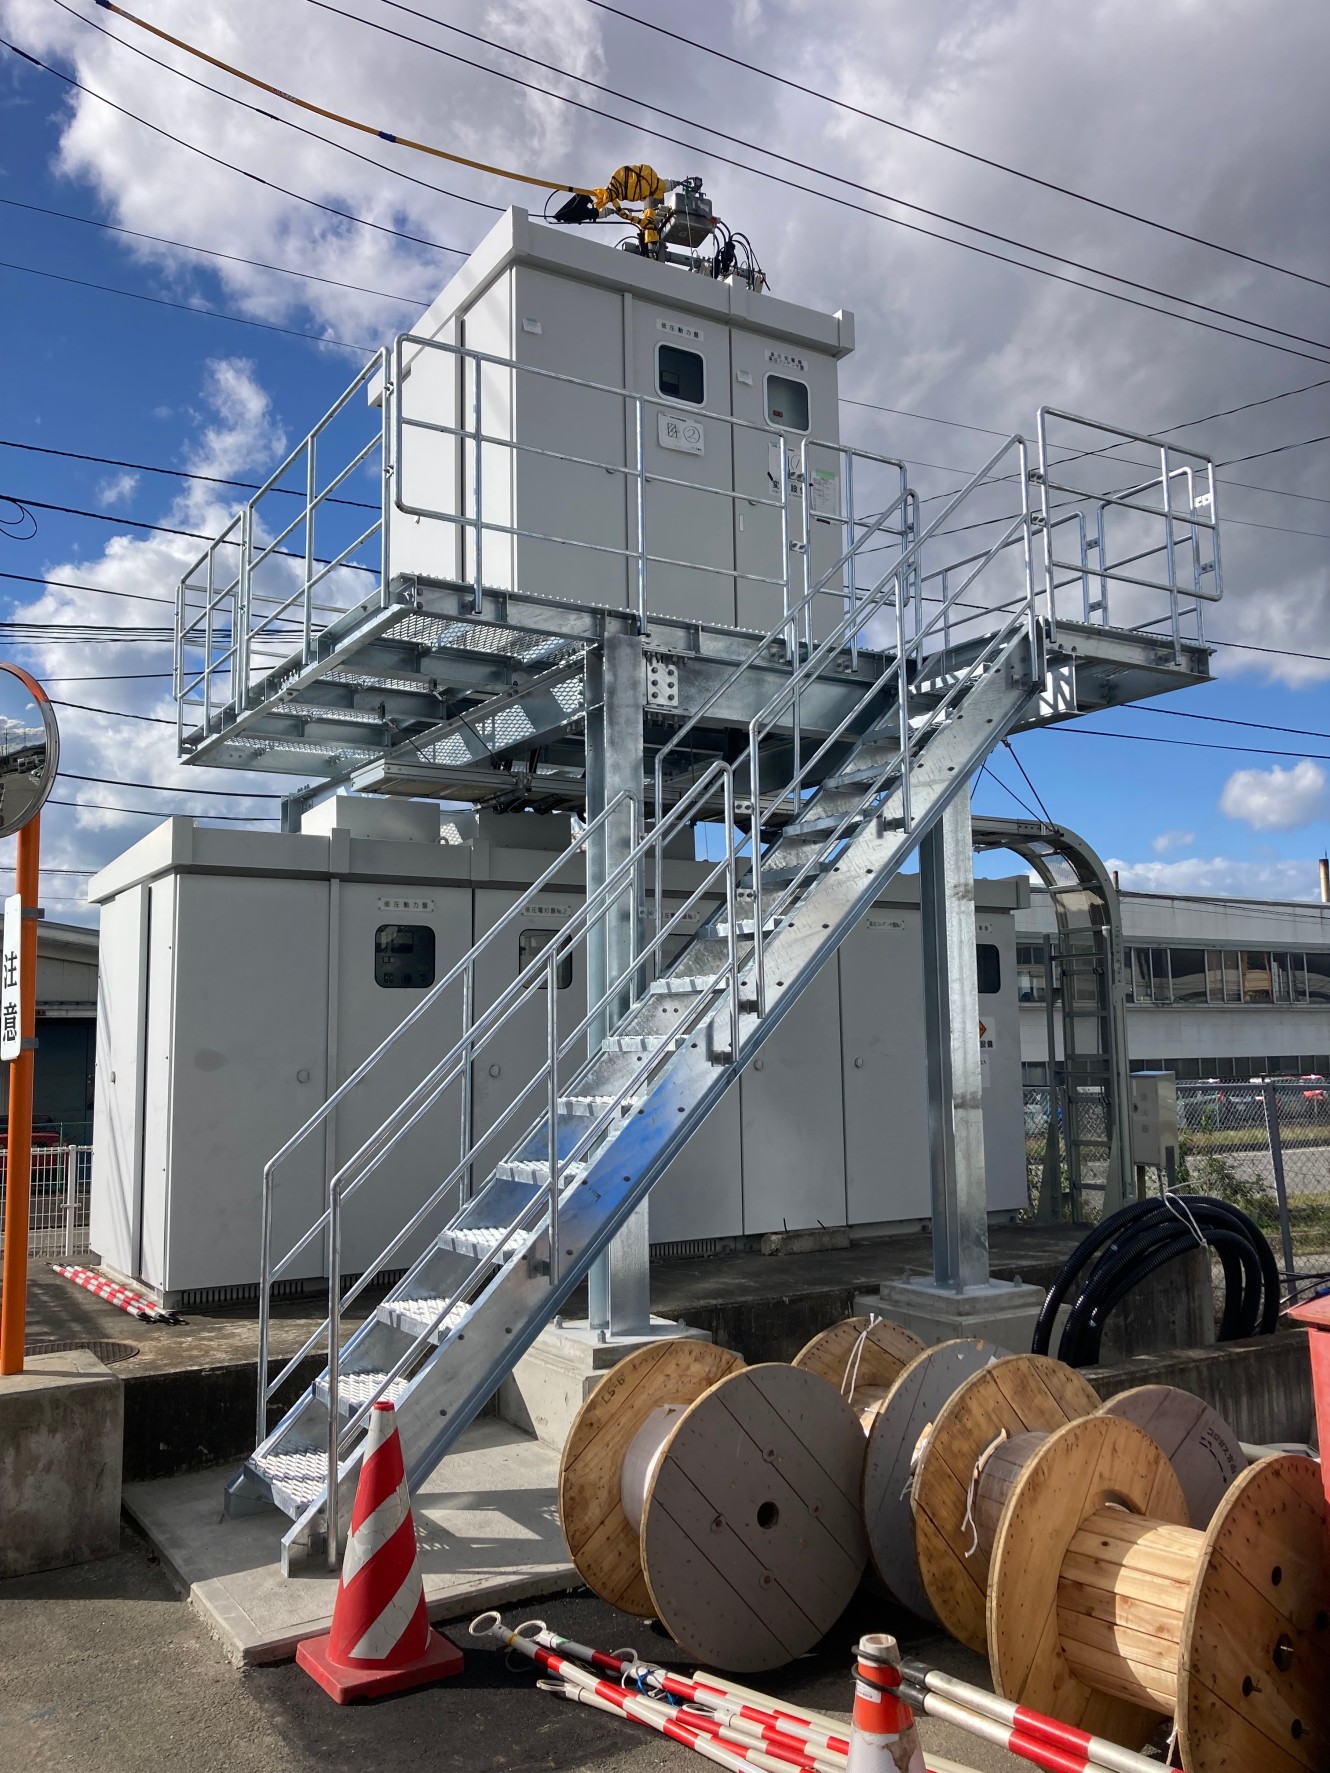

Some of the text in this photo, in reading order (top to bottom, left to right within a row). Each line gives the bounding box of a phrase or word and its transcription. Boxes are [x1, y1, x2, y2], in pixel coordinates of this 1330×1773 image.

[384, 900, 428, 910] 低圧動力盤
[3, 950, 18, 1043] 注意
